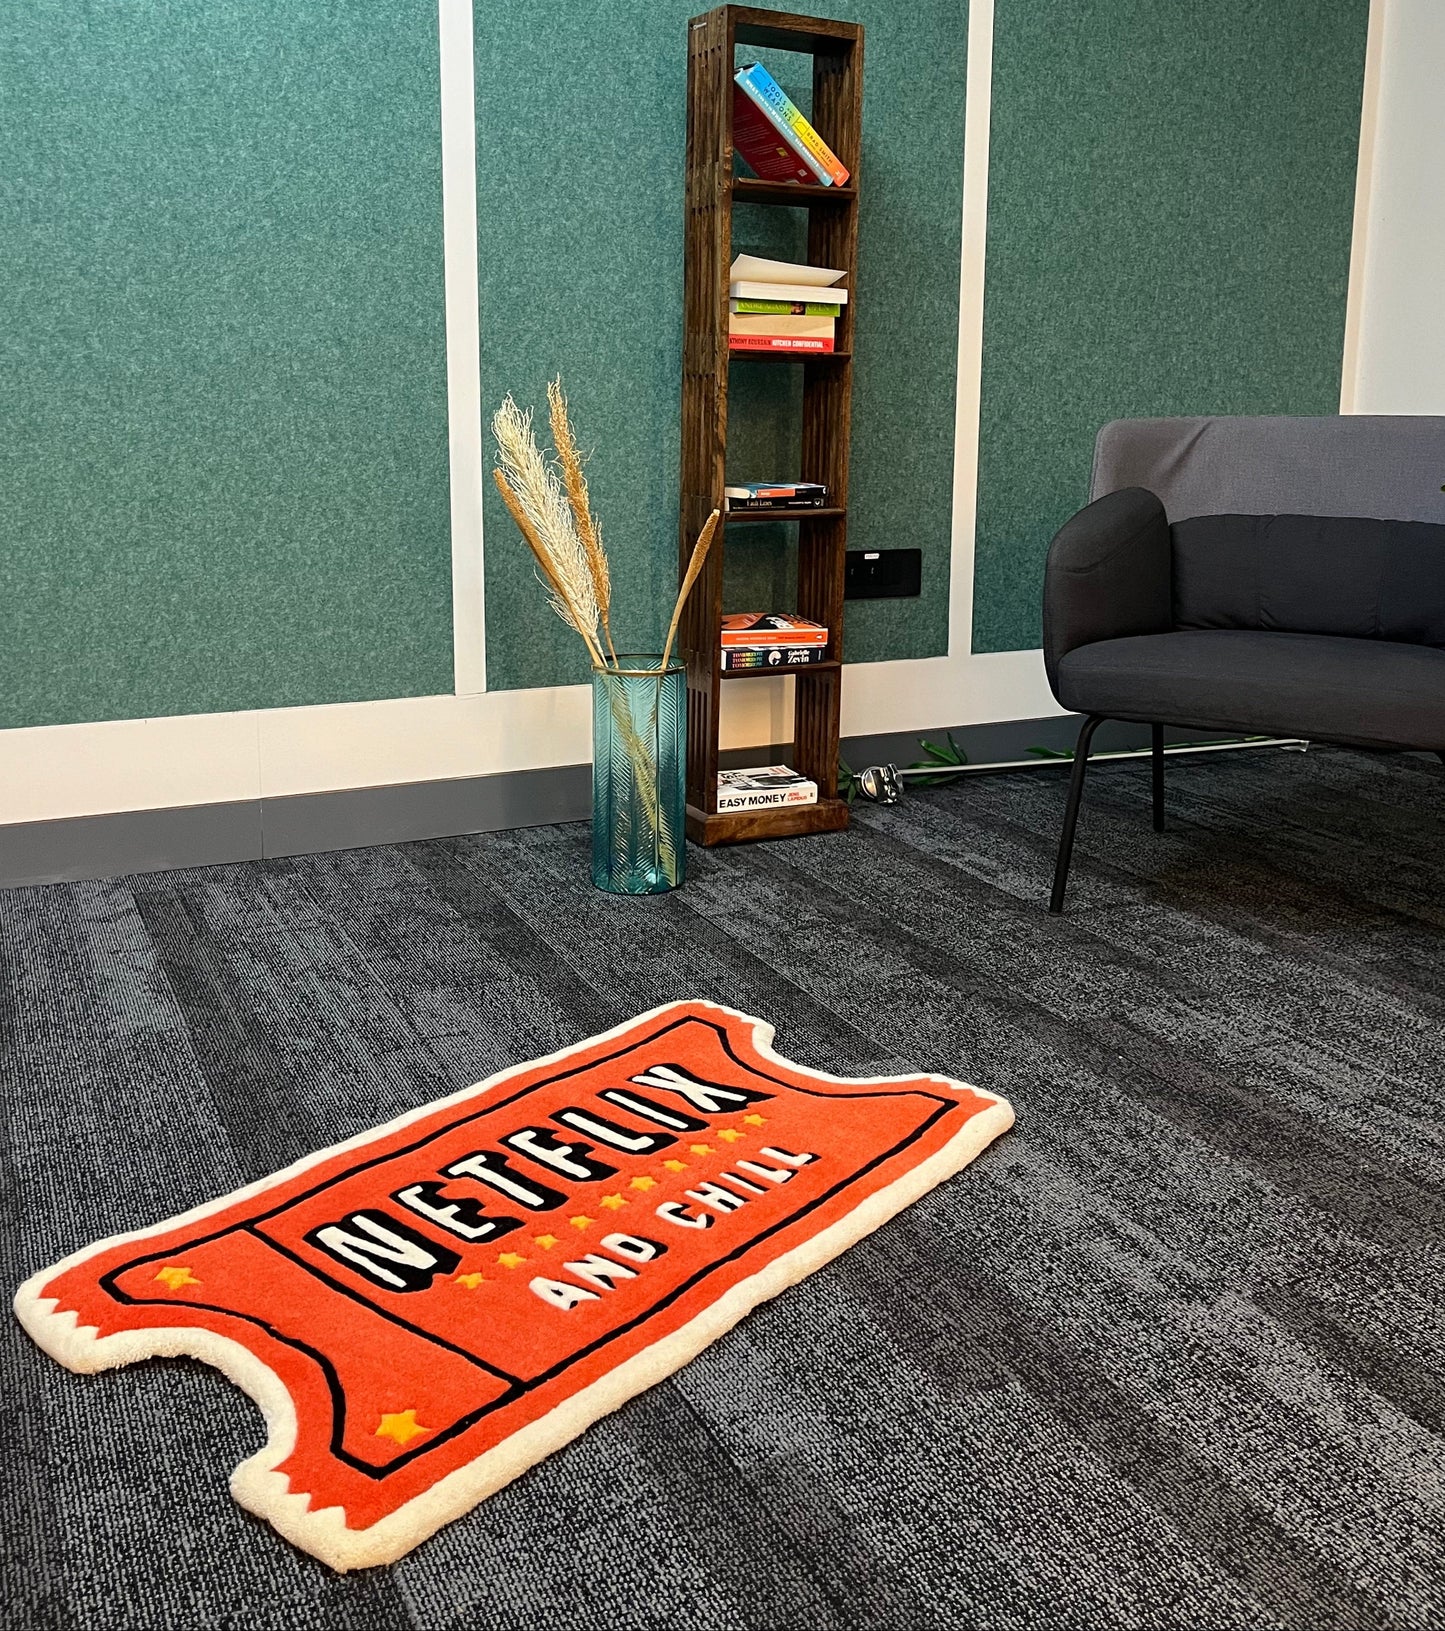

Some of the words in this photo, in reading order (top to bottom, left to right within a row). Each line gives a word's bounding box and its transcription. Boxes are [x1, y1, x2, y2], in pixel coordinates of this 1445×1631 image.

[763, 88, 792, 122] WEAPONS
[767, 82, 787, 106] TOOLS
[806, 132, 819, 147] BRAD
[819, 147, 833, 164] SMITH
[787, 655, 810, 664] Zevin
[719, 797, 747, 808] EASY
[748, 793, 786, 805] MONEY
[308, 1063, 766, 1291] NETFLIX
[528, 1232, 667, 1310] AND
[655, 1146, 821, 1229] CHILL
